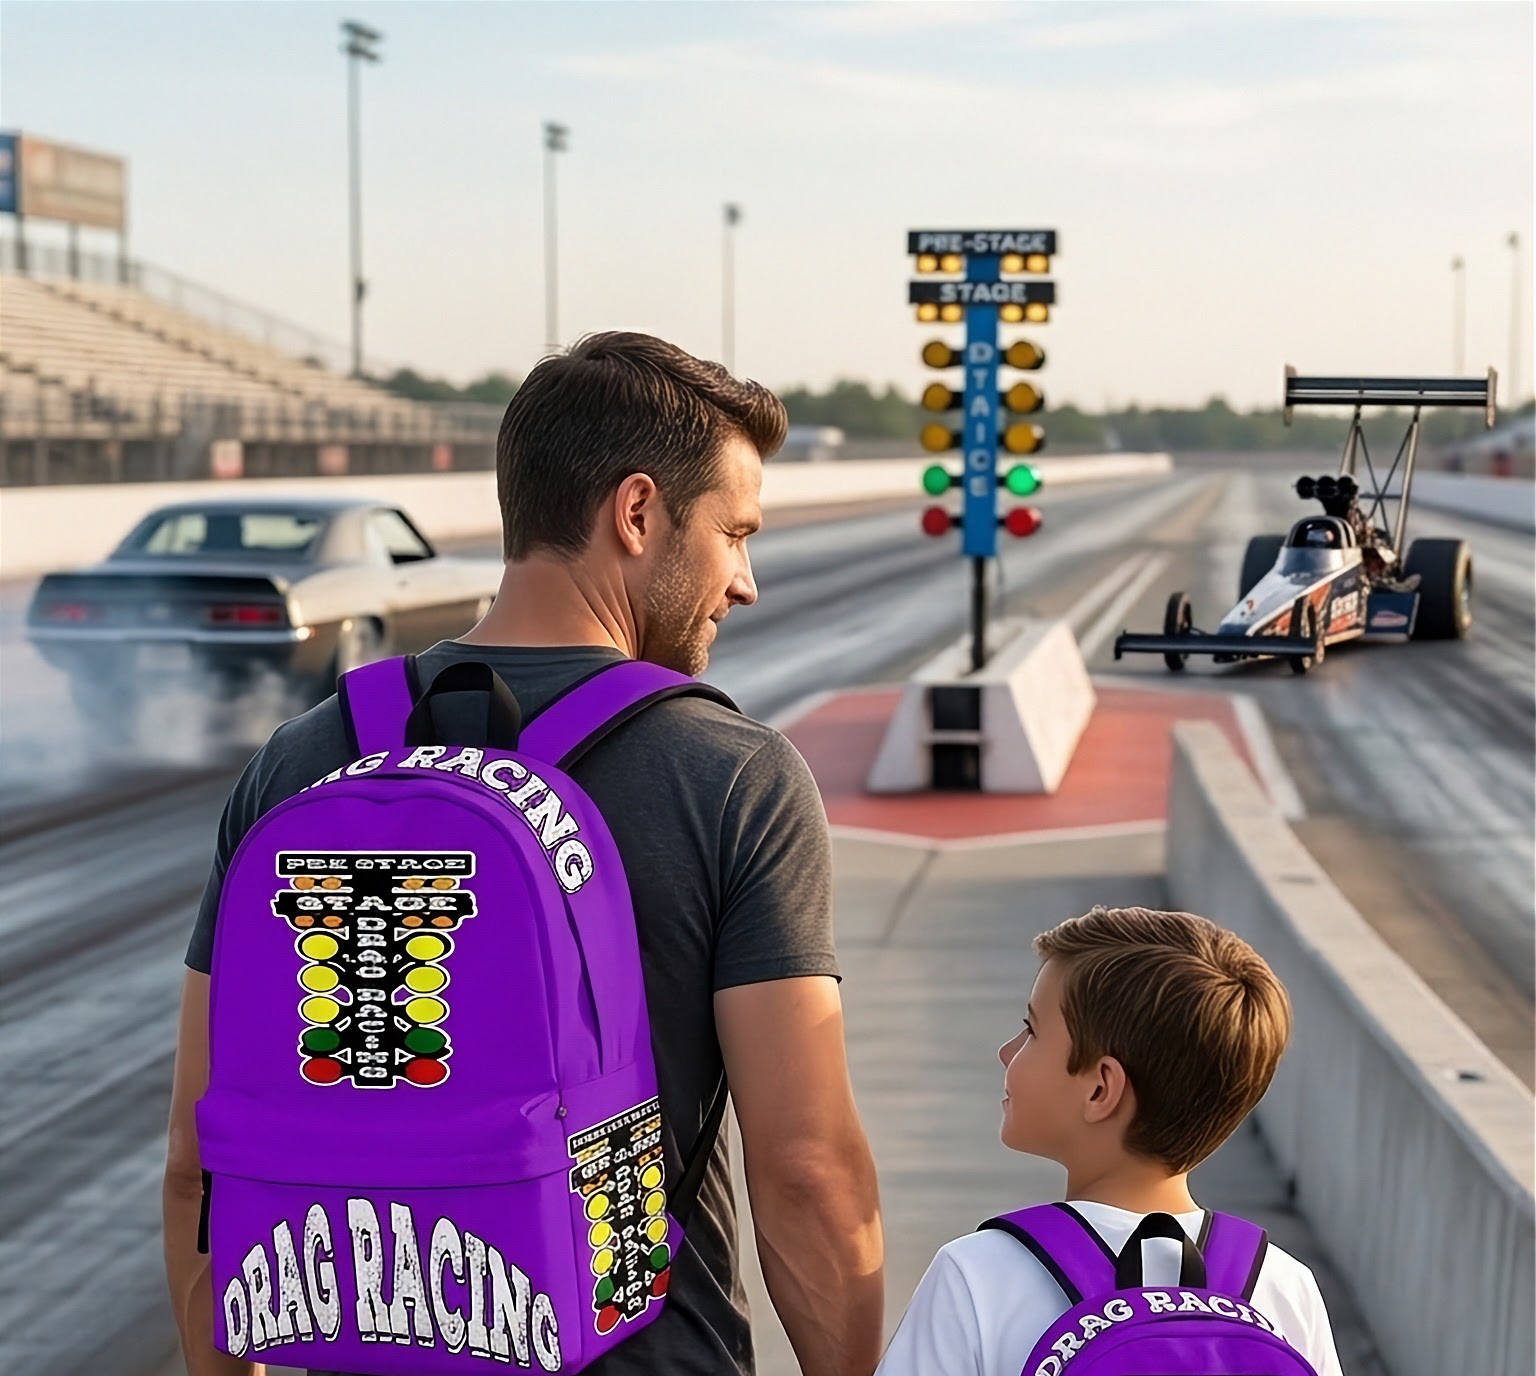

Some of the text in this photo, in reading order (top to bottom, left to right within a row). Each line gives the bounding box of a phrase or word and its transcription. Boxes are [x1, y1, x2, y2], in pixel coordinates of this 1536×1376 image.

[917, 233, 1047, 252] PRE-STAGE
[398, 746, 594, 895] RACING
[223, 1203, 341, 1357] DRAG
[347, 1198, 562, 1372] RACING
